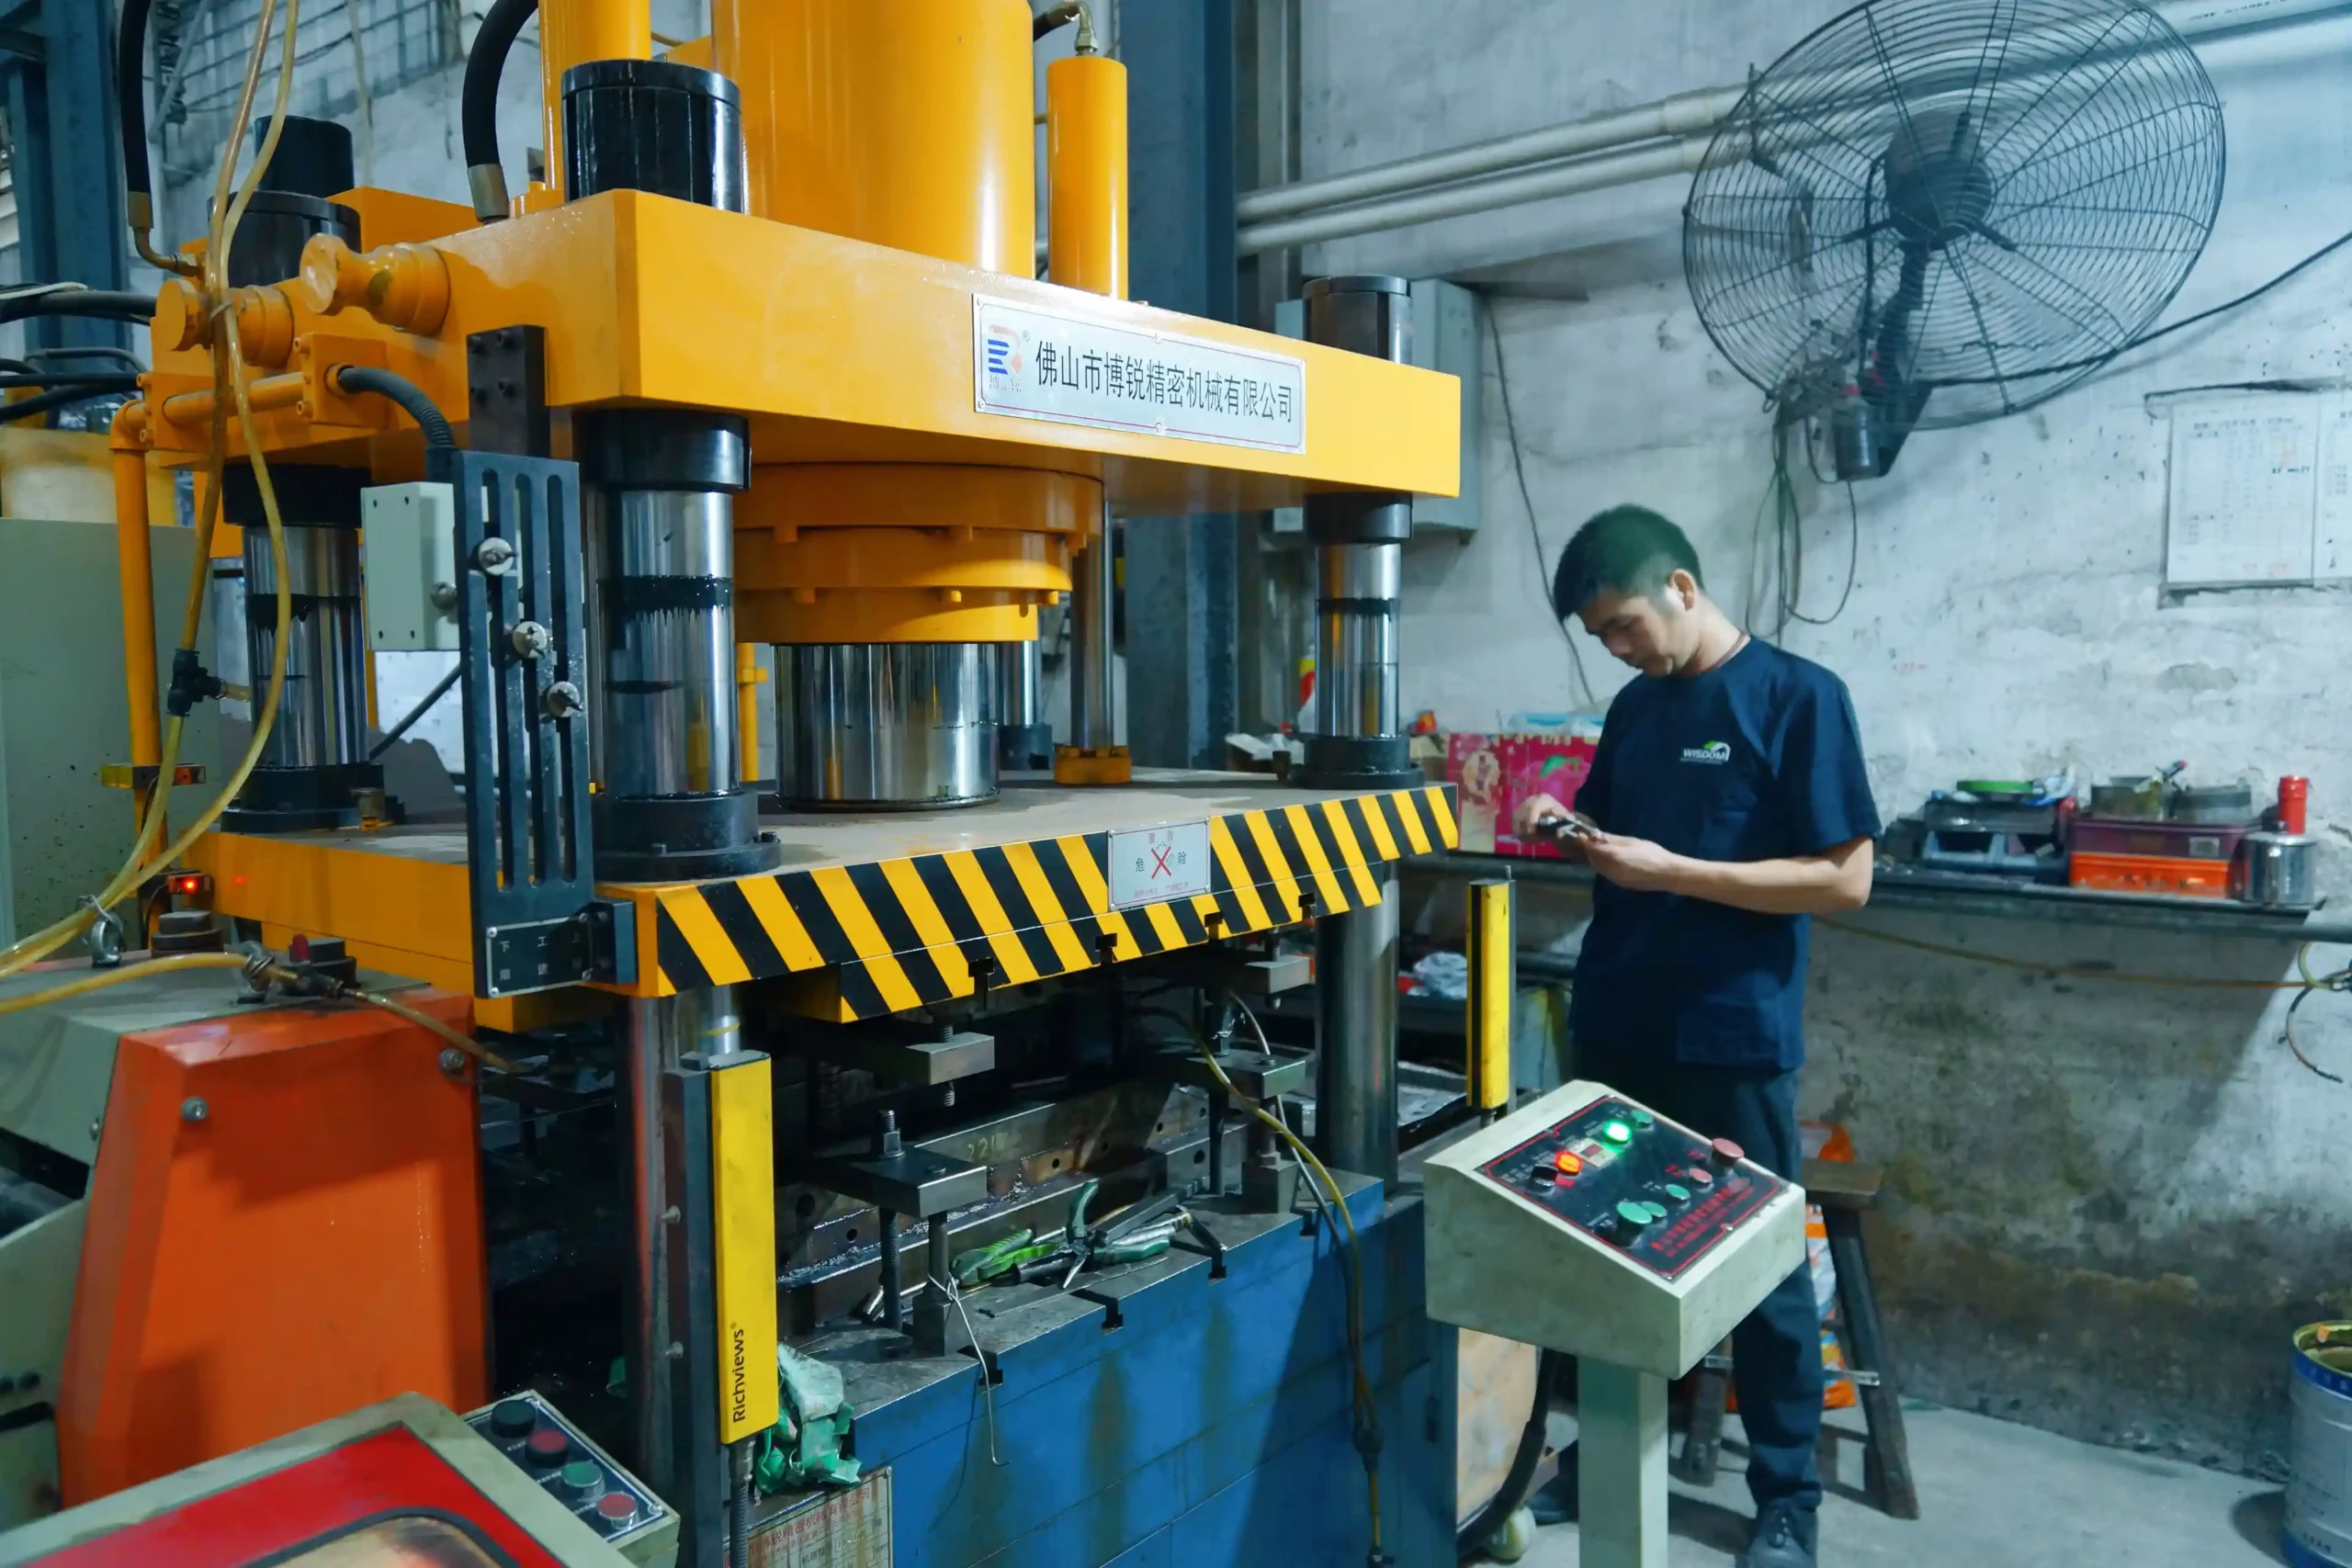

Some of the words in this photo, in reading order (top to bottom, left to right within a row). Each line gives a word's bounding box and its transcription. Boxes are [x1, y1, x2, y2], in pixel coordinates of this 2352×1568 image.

[1035, 340, 1292, 423] 佛山市博锐精密机械有限公司
[732, 1328, 746, 1424] Richviews
